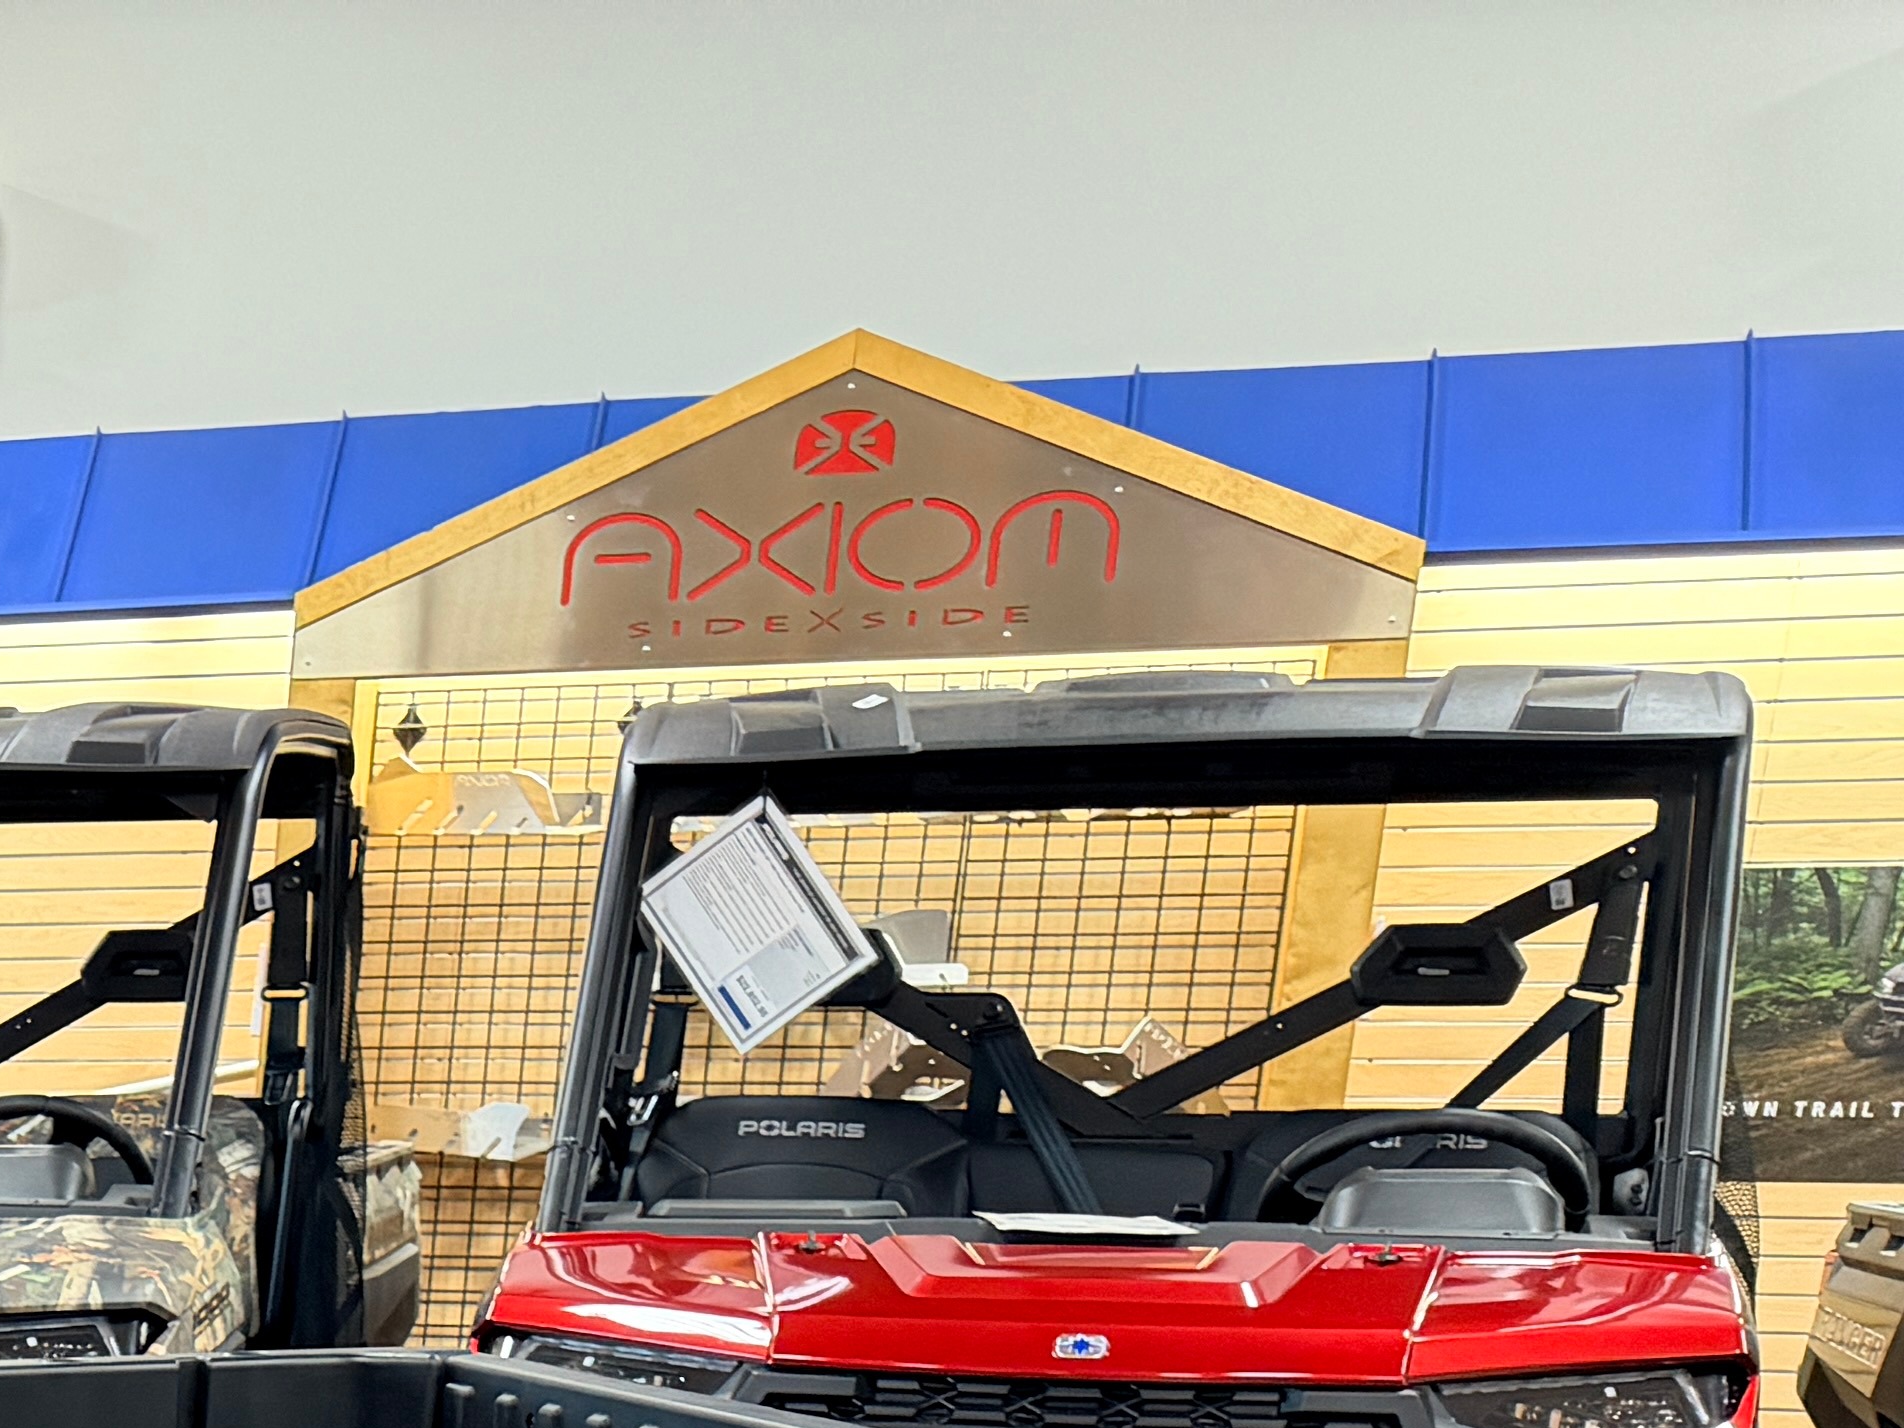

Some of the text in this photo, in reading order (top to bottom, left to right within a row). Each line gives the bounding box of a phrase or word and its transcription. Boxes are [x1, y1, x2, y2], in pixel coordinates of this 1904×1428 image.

[561, 490, 1119, 605] AXIOM
[1794, 1101, 1874, 1118] TRAIL
[738, 1119, 866, 1139] POLARIS
